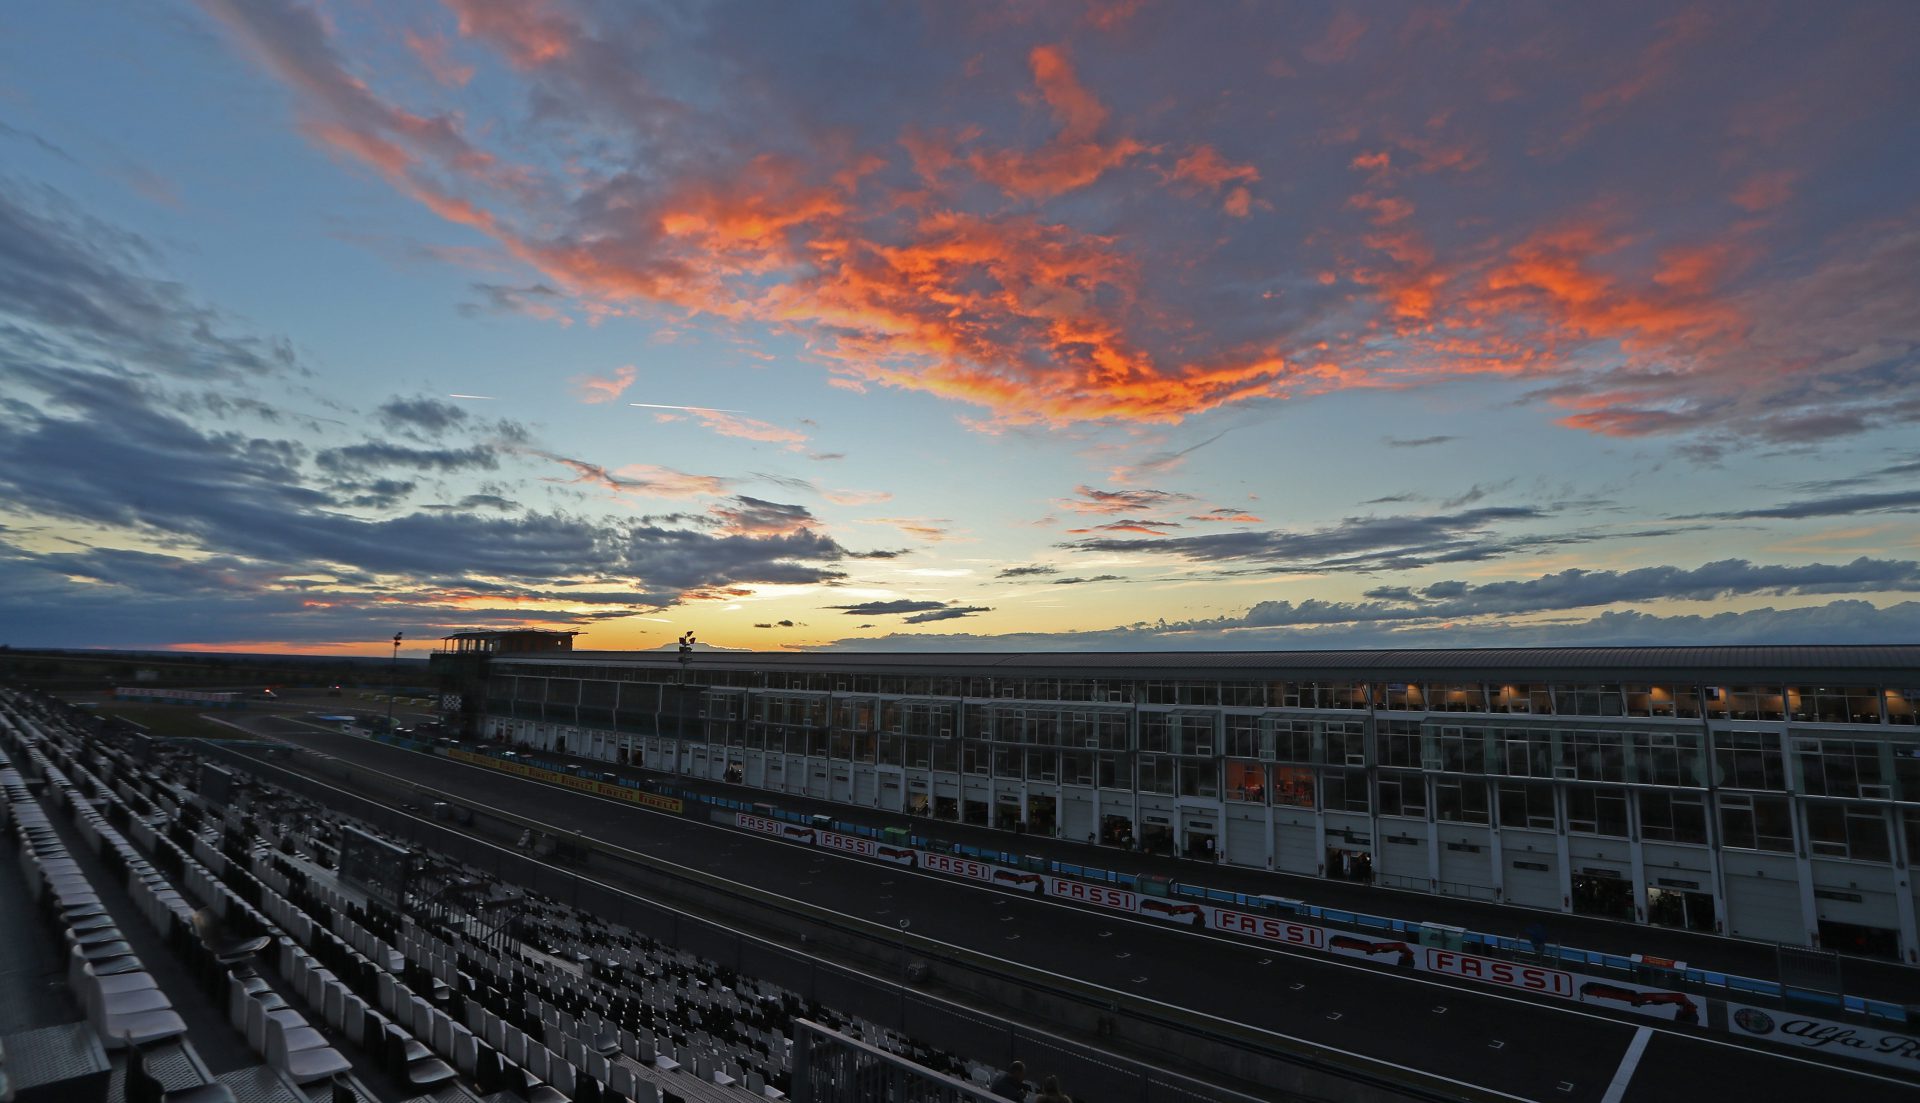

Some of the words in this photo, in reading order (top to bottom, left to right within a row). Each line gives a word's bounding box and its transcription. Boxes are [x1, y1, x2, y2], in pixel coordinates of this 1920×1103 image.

[561, 775, 593, 790] PIRELLI
[598, 784, 633, 800] PIRELLI
[639, 793, 680, 811] PIRELLI
[740, 816, 779, 832] FASSI
[825, 835, 873, 853] FASSI
[928, 856, 985, 877] FASSI
[1057, 882, 1129, 907] FASSI
[1222, 914, 1315, 943] FASSI
[1437, 953, 1559, 992] FASSI
[1780, 1020, 1872, 1048] Alfa
